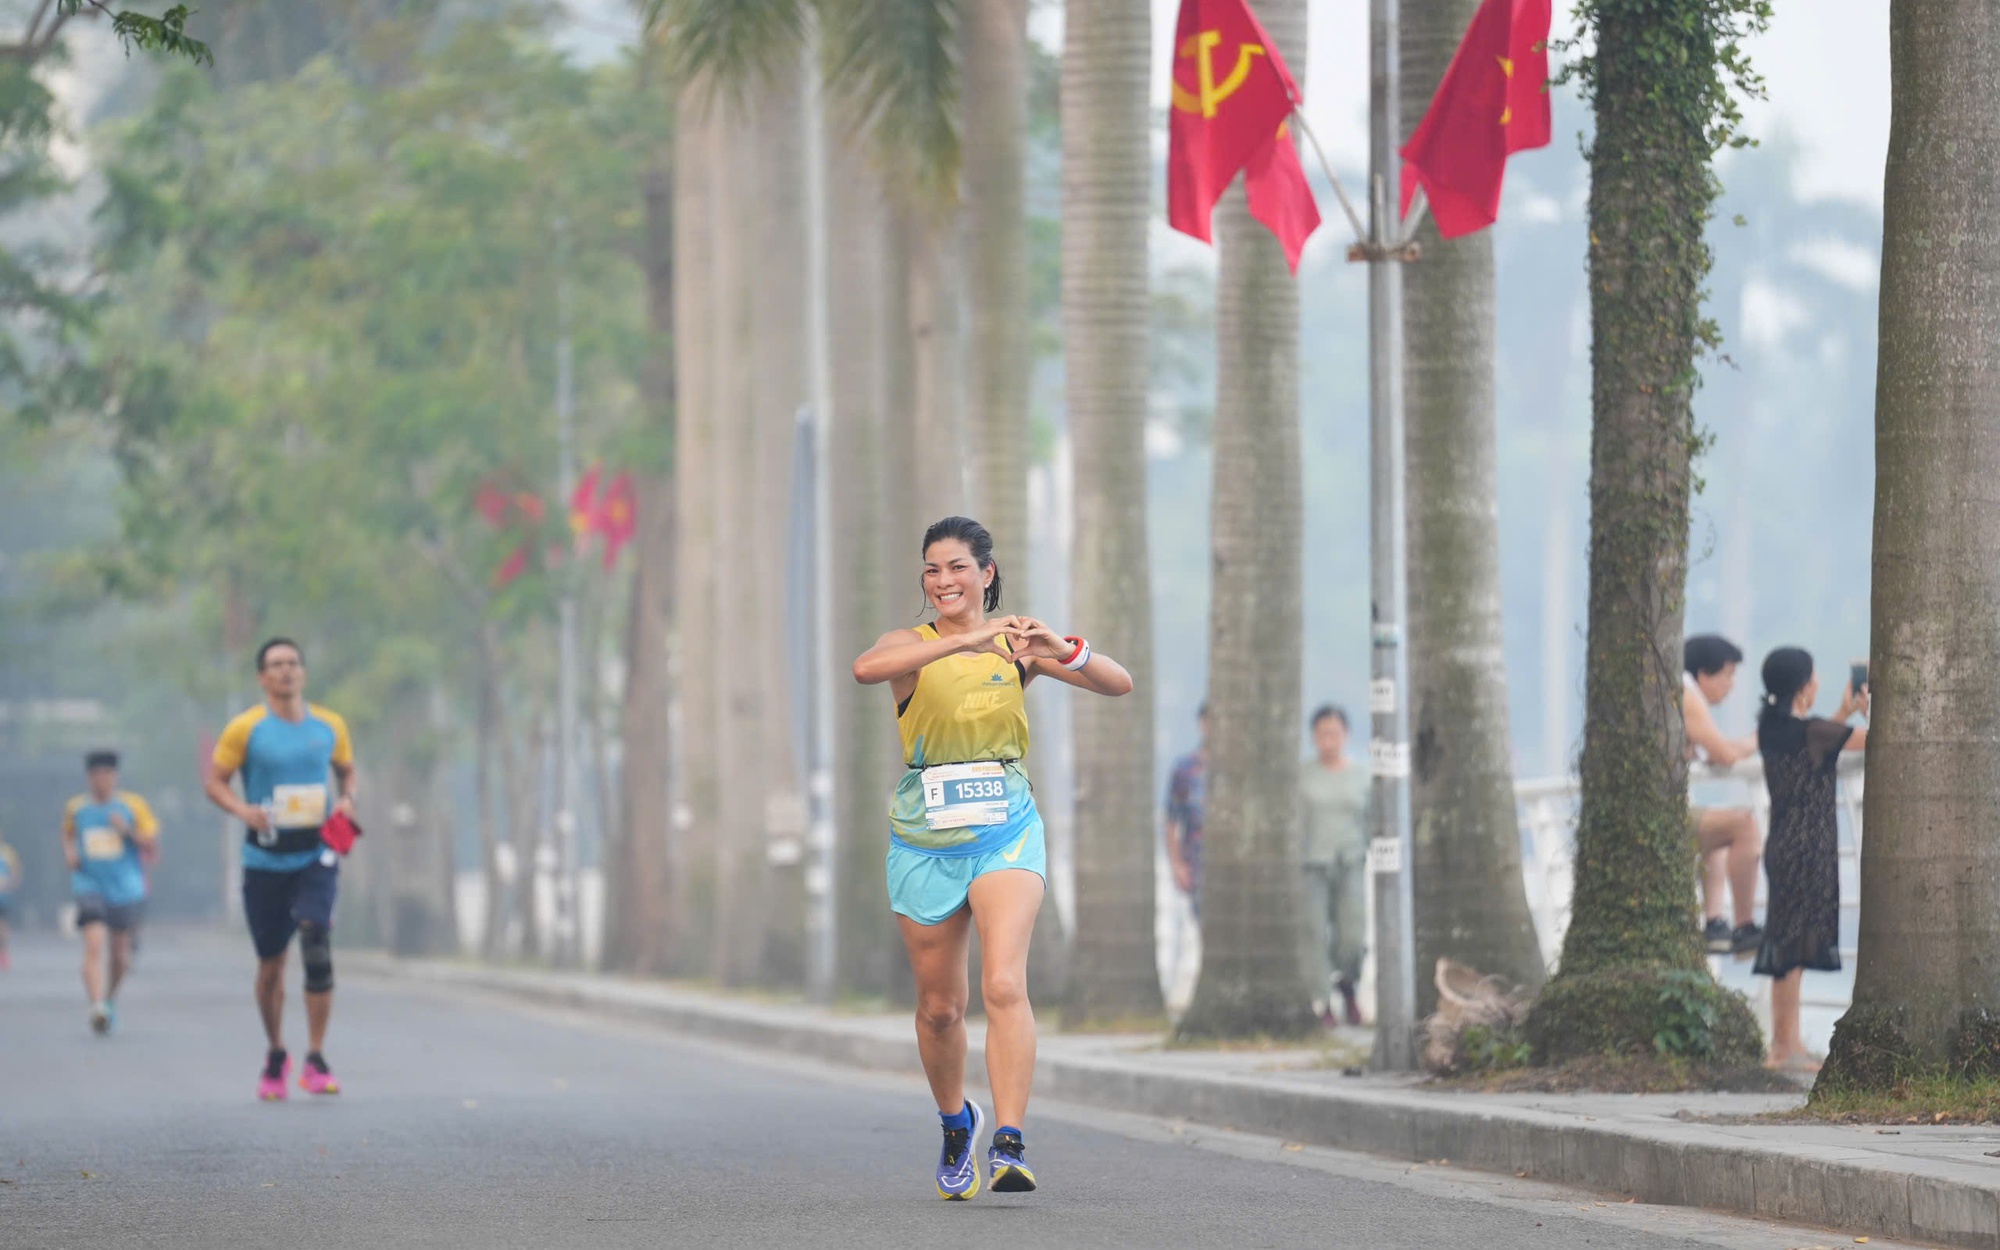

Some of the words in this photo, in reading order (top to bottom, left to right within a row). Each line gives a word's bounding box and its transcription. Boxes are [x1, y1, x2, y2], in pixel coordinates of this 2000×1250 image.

[963, 691, 1000, 708] NIKE
[931, 788, 938, 800] F
[956, 781, 1004, 799] 15338
